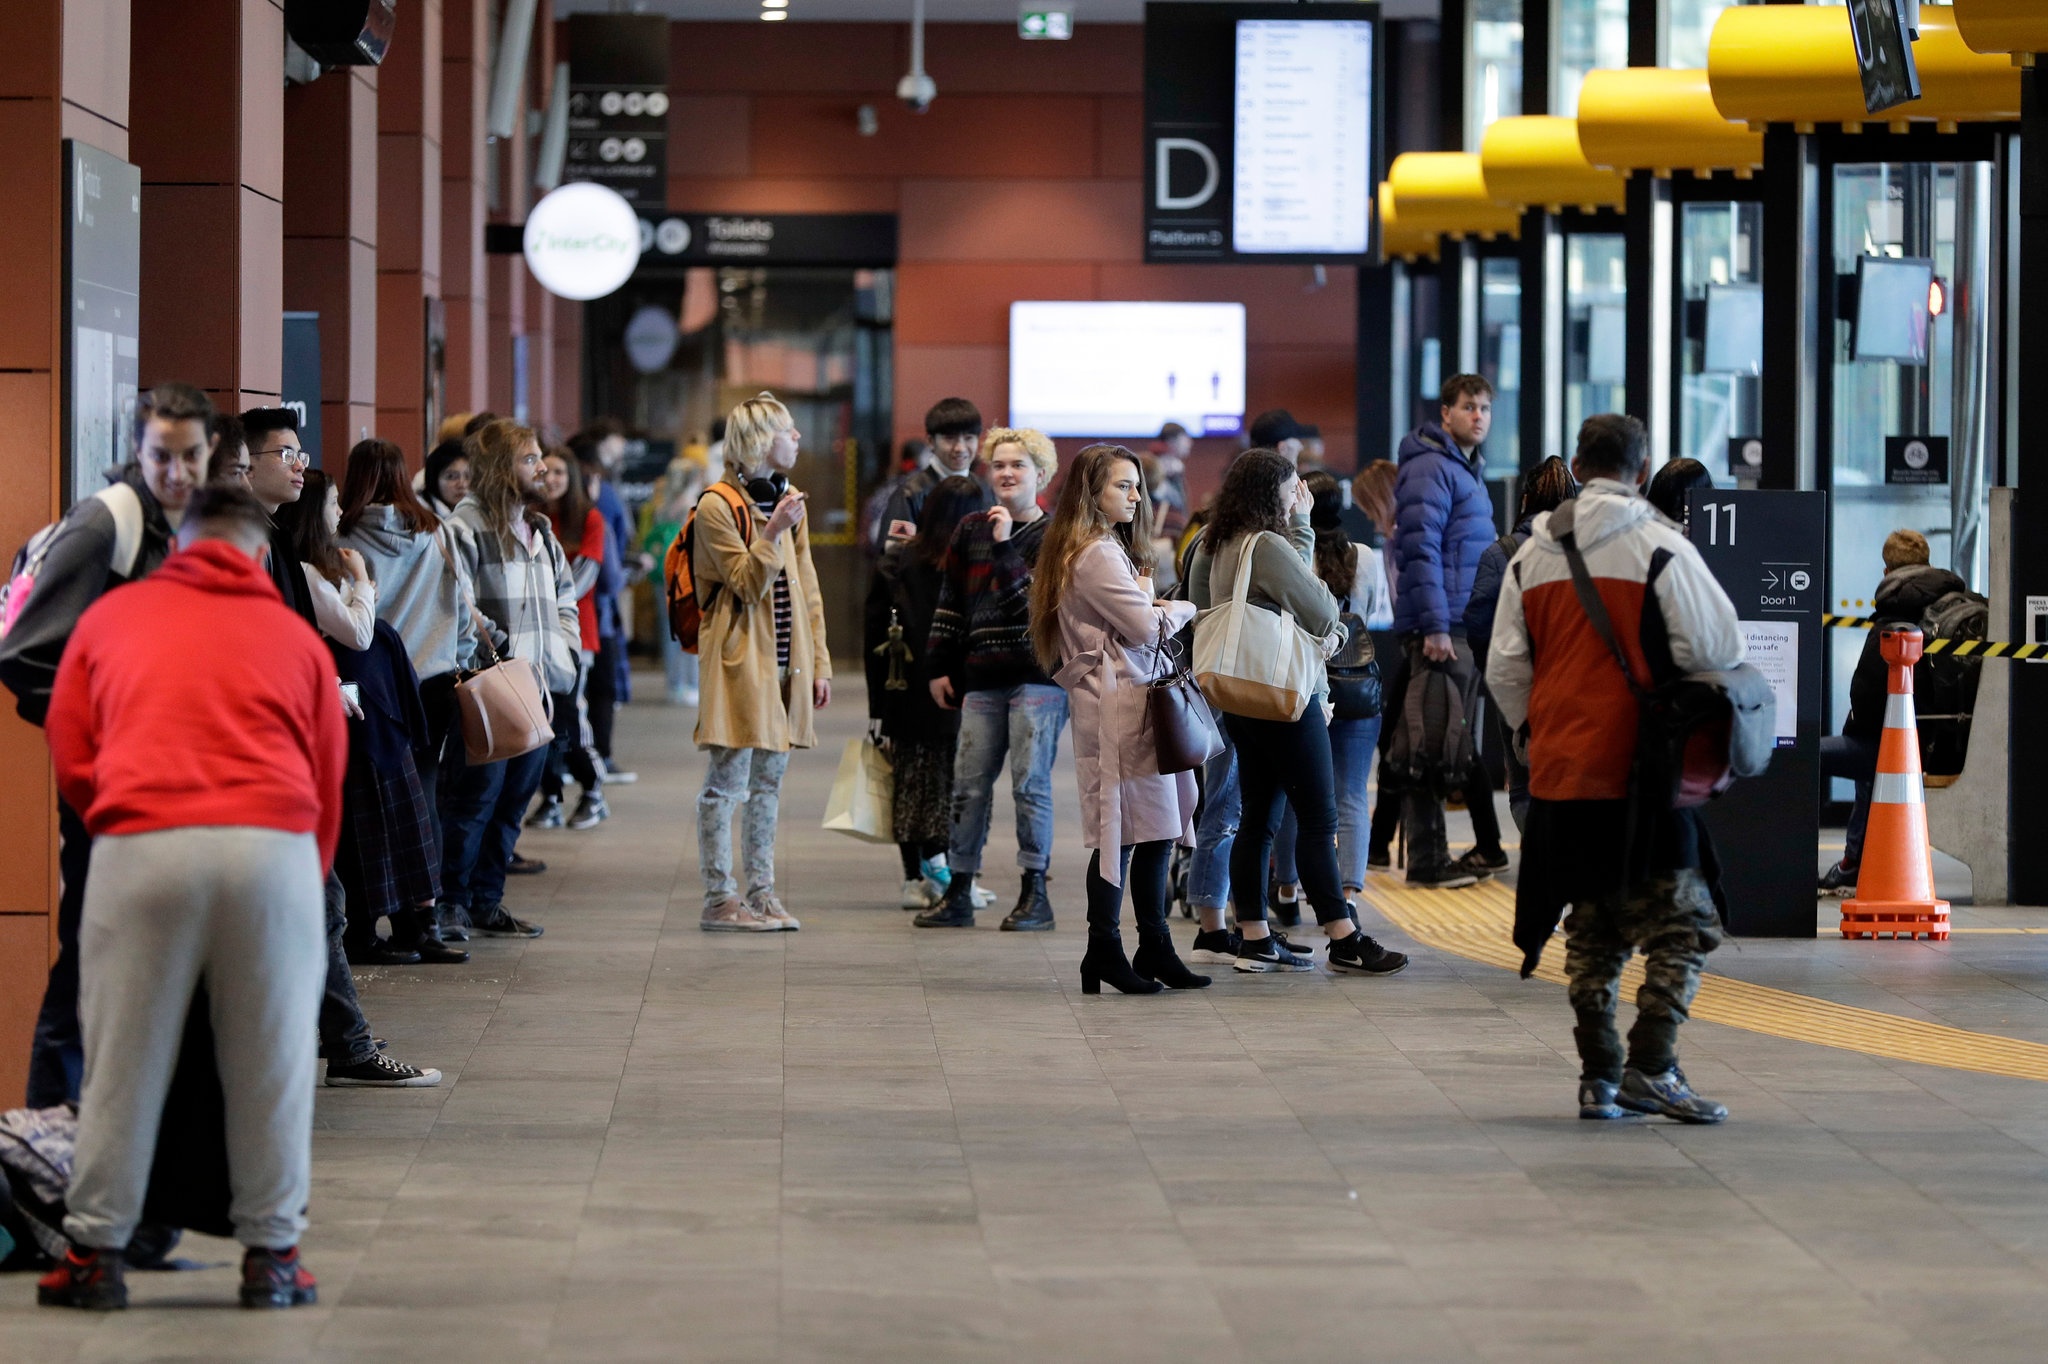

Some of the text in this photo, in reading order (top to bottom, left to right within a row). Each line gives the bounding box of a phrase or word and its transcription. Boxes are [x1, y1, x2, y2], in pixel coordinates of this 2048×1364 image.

[1156, 138, 1220, 210] D
[1702, 503, 1736, 545] 11
[1760, 595, 1796, 605] Door 11
[1750, 634, 1789, 643] distancing
[1763, 643, 1779, 651] safe
